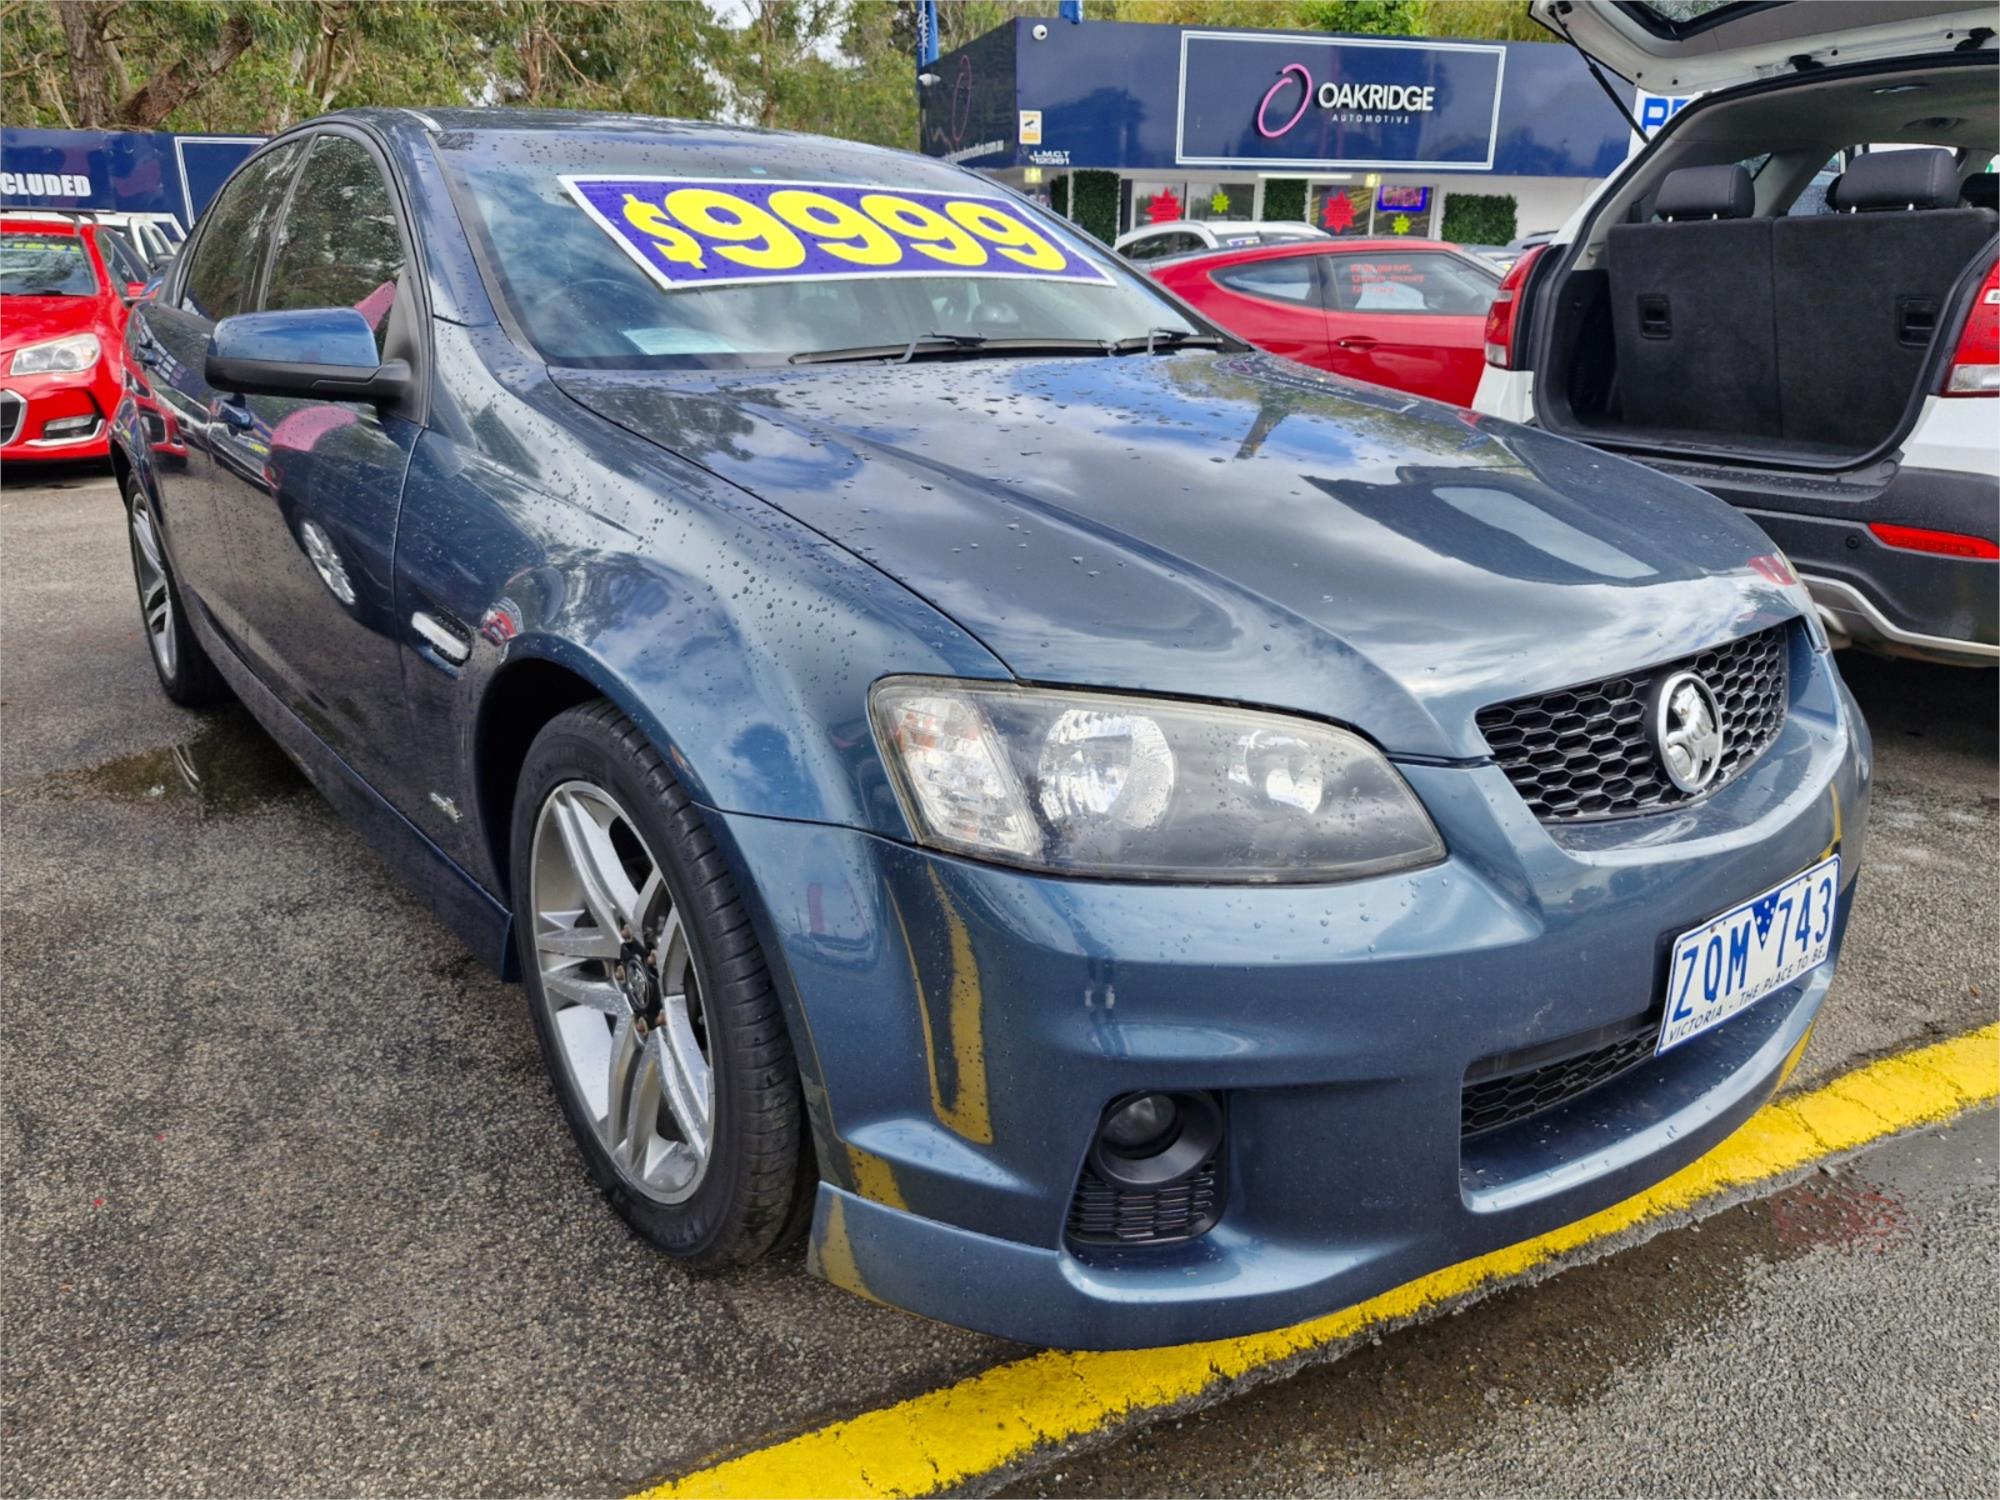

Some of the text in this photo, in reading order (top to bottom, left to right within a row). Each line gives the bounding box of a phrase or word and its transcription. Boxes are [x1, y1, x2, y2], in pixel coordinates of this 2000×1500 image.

[1318, 82, 1435, 111] OAKRIDGE
[1332, 113, 1409, 124] AUTOMOTIVE
[622, 189, 1067, 270] $9999
[1672, 877, 1832, 1023] ZQM 743
[1669, 1005, 1722, 1042] VICTORIA
[1739, 984, 1759, 1006] THE
[1764, 964, 1793, 991] PLACE
[1797, 952, 1807, 971] TO
